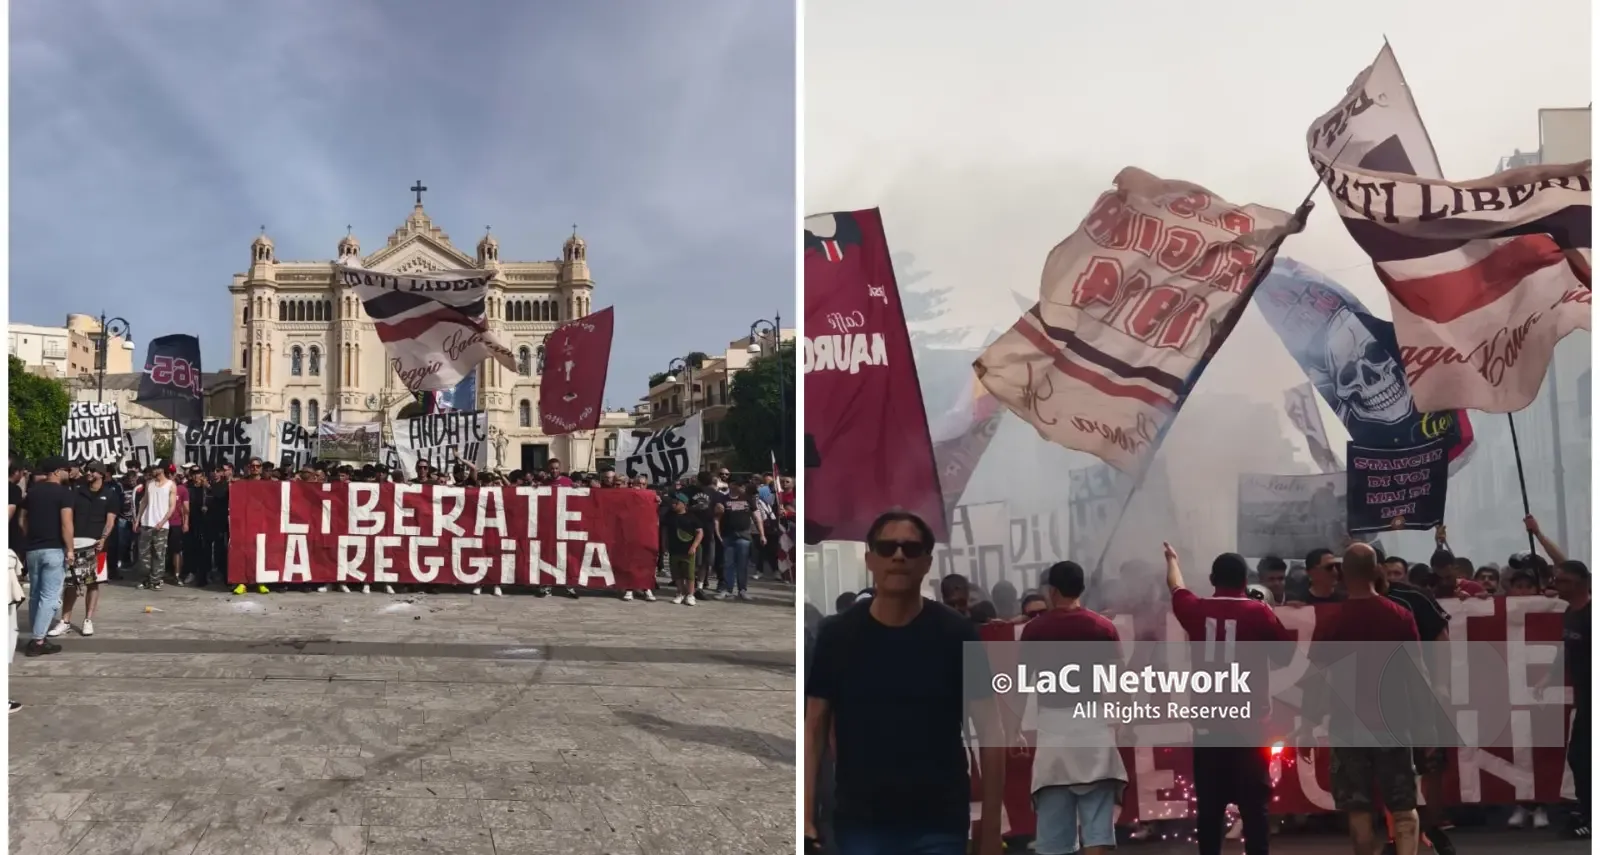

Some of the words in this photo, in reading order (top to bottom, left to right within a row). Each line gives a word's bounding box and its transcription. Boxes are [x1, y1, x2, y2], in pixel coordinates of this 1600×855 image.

[409, 411, 486, 449] ANDATE
[631, 421, 686, 456] THE
[255, 532, 313, 584] LA
